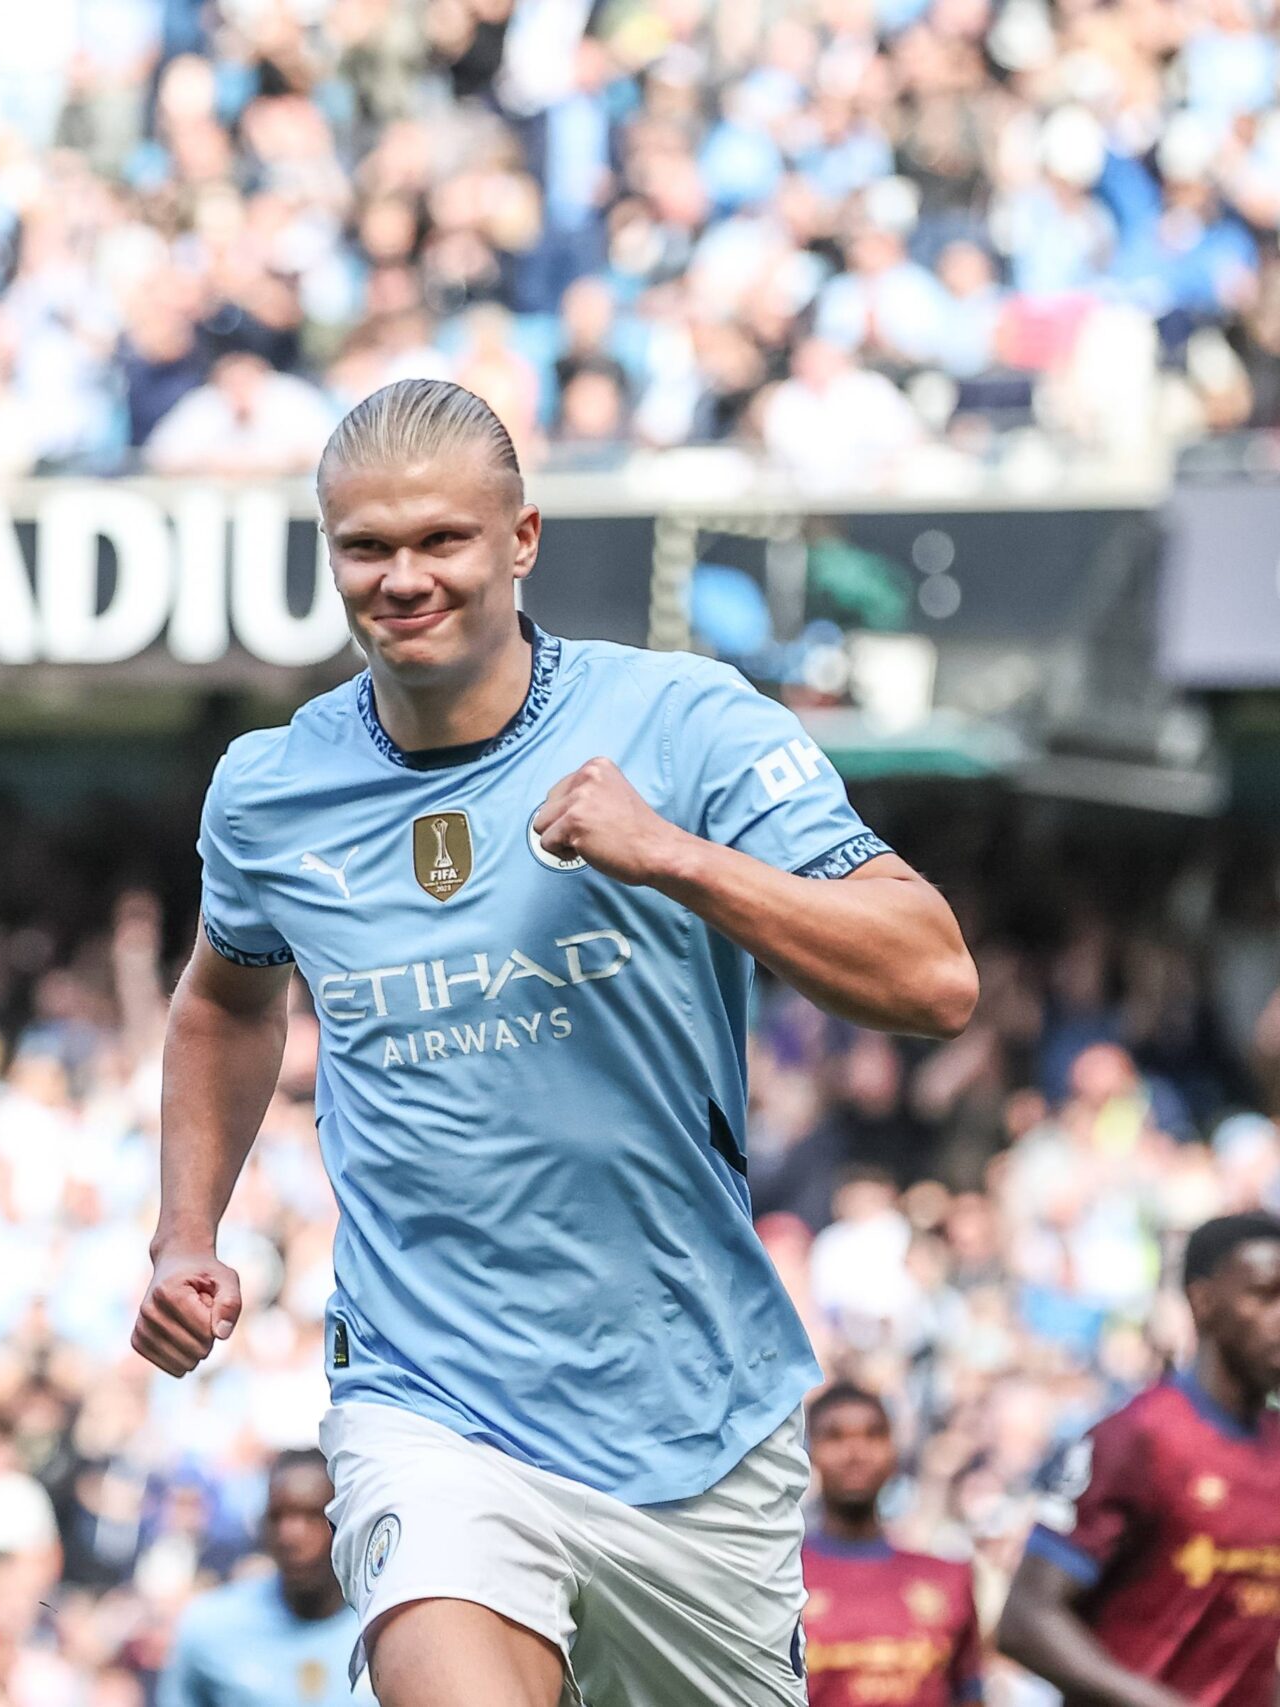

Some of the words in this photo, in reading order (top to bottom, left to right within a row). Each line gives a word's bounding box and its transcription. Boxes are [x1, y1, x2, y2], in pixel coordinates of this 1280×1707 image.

[430, 867, 458, 882] FIFA
[320, 928, 632, 1020] ETIHAD
[383, 1007, 573, 1068] AIRWAYS
